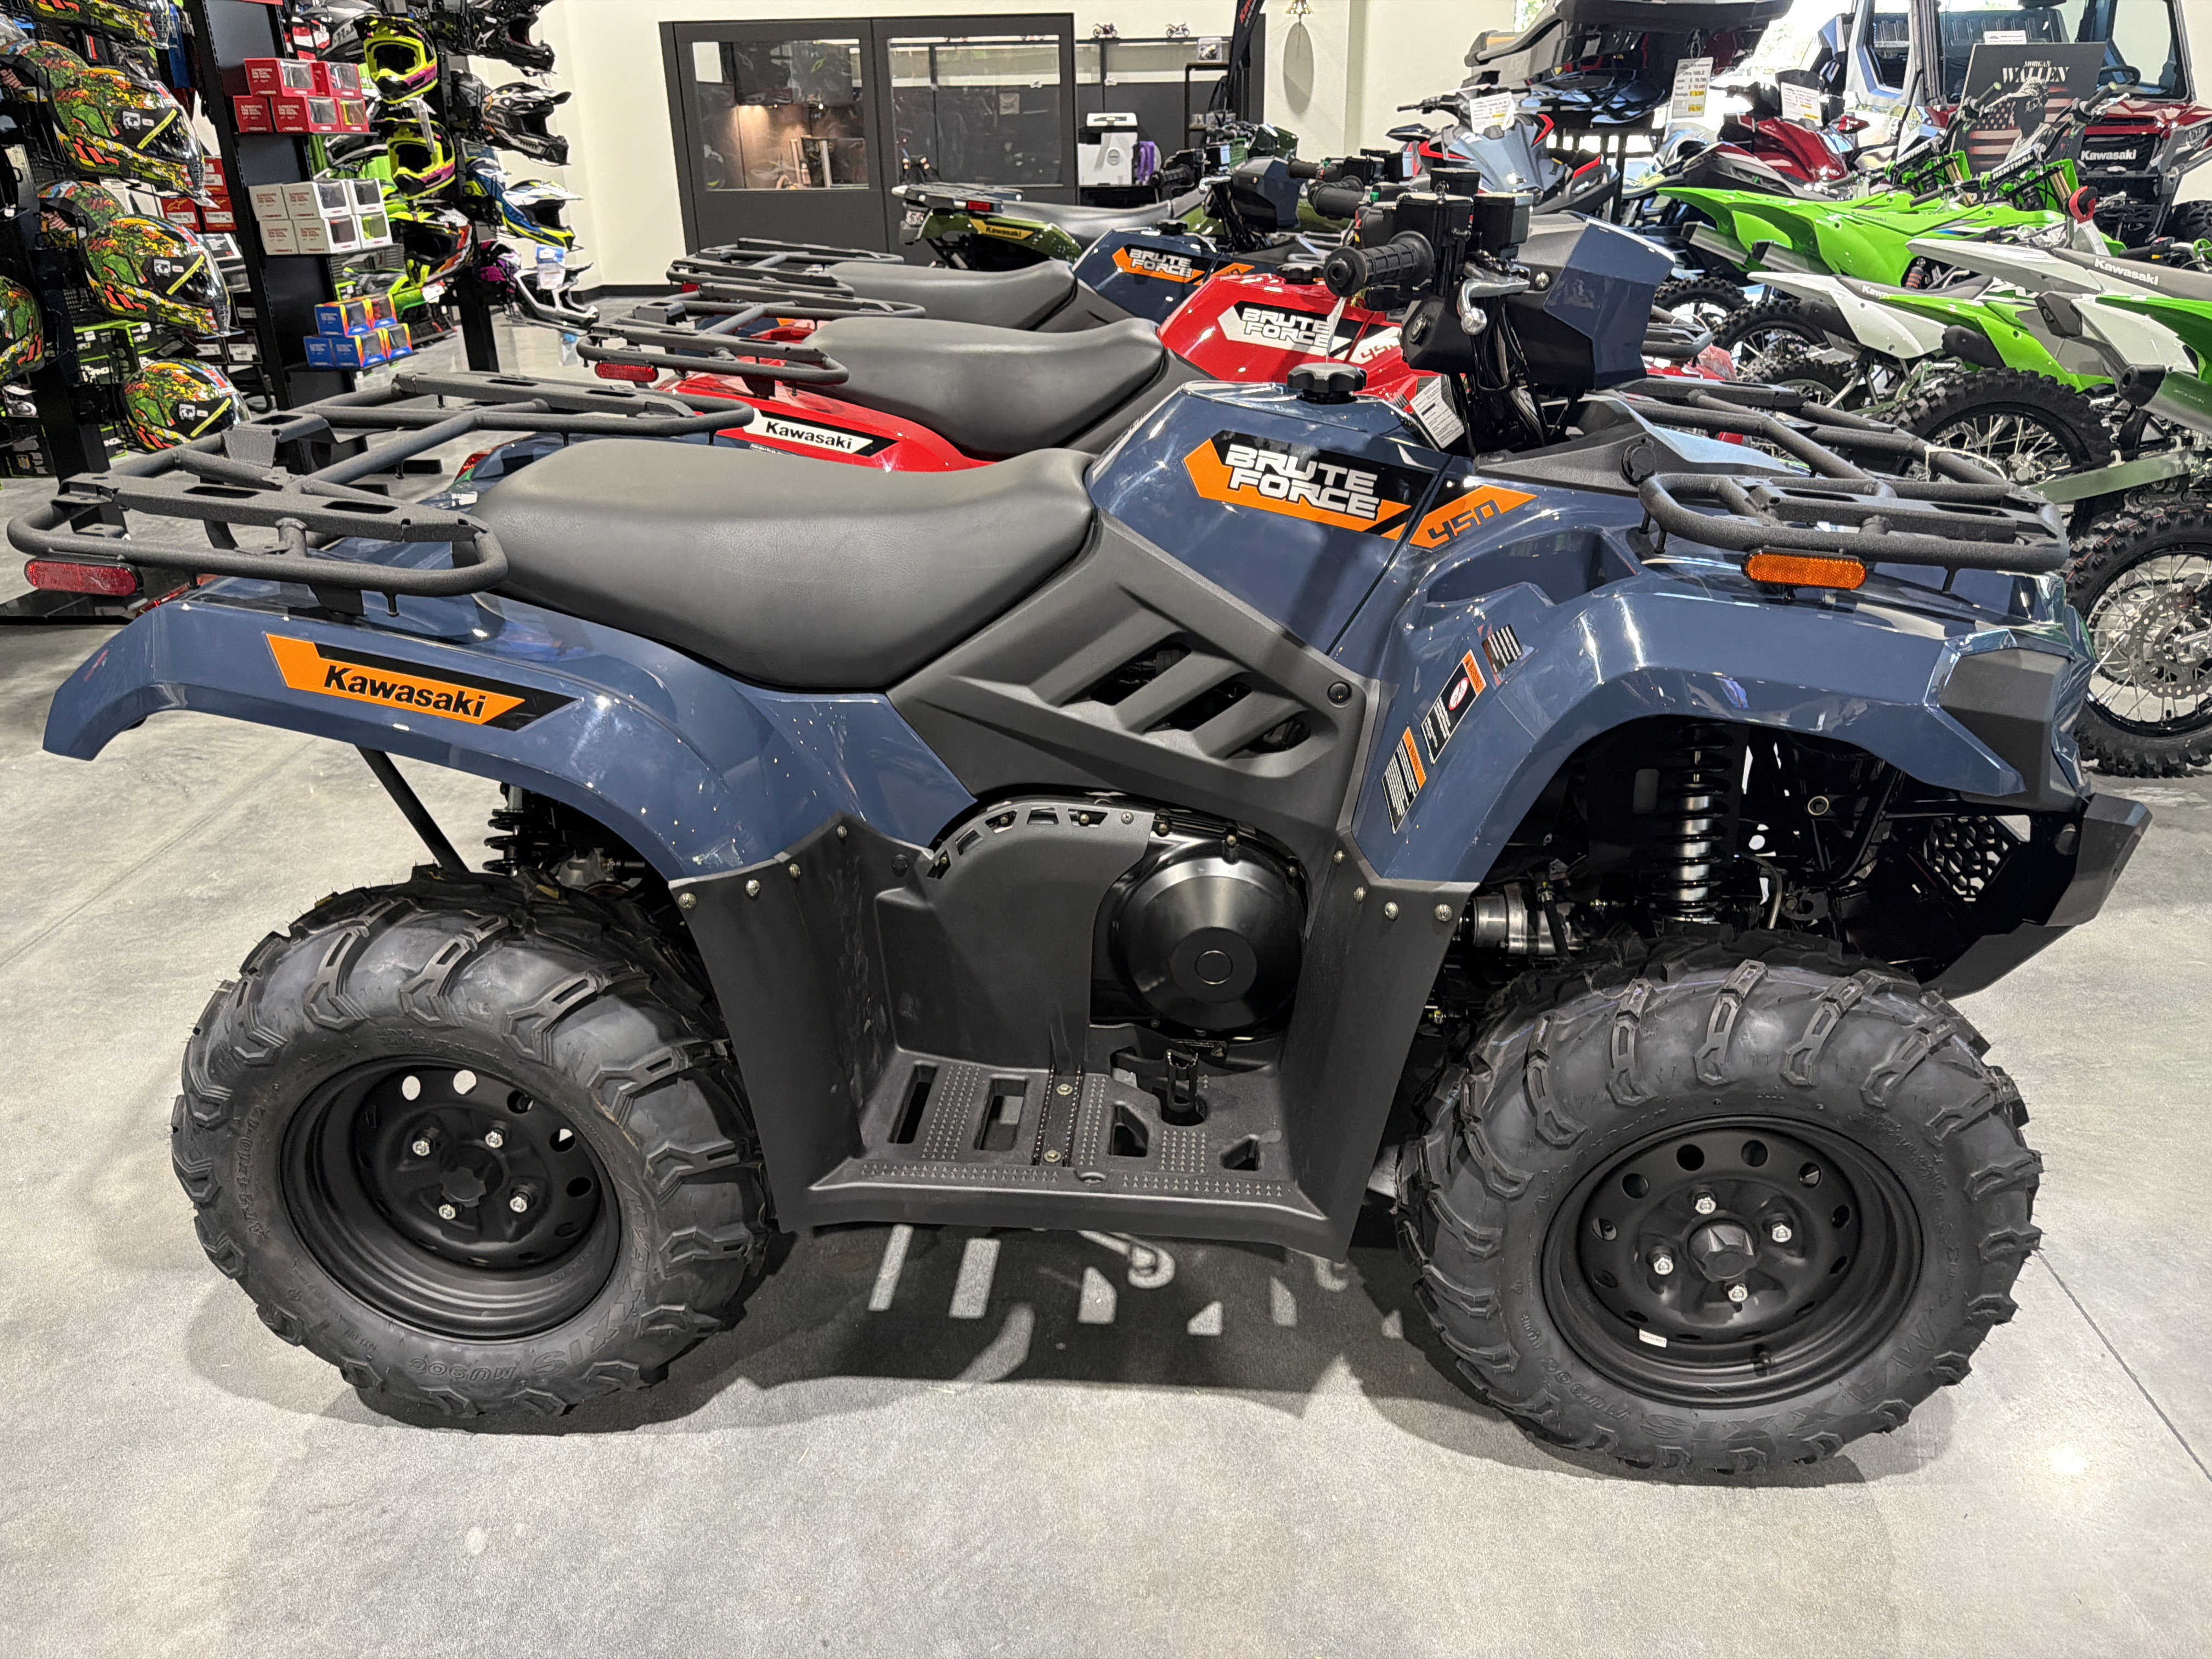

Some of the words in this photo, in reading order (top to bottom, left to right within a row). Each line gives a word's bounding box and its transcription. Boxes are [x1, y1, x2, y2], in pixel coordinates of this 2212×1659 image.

[2002, 66, 2070, 83] WALLEN
[1993, 154, 2034, 180] RENTHAL
[2080, 149, 2137, 160] Kawasaki
[986, 226, 1022, 237] Kawasaki
[1130, 249, 1192, 267] BRUTE
[1131, 258, 1193, 278] FORCE
[2095, 258, 2159, 285] Kawasaki
[1242, 308, 1330, 332] BRUTE
[1244, 321, 1330, 348] FORCE
[765, 421, 853, 449] Kawasaki
[1225, 444, 1378, 493] BRUTE
[1229, 469, 1380, 518] FORCE
[1426, 499, 1502, 544] 450
[323, 665, 488, 718] Kawasaki
[534, 1180, 650, 1375] MAXXIS
[1639, 1316, 1940, 1440] MAXXIS
